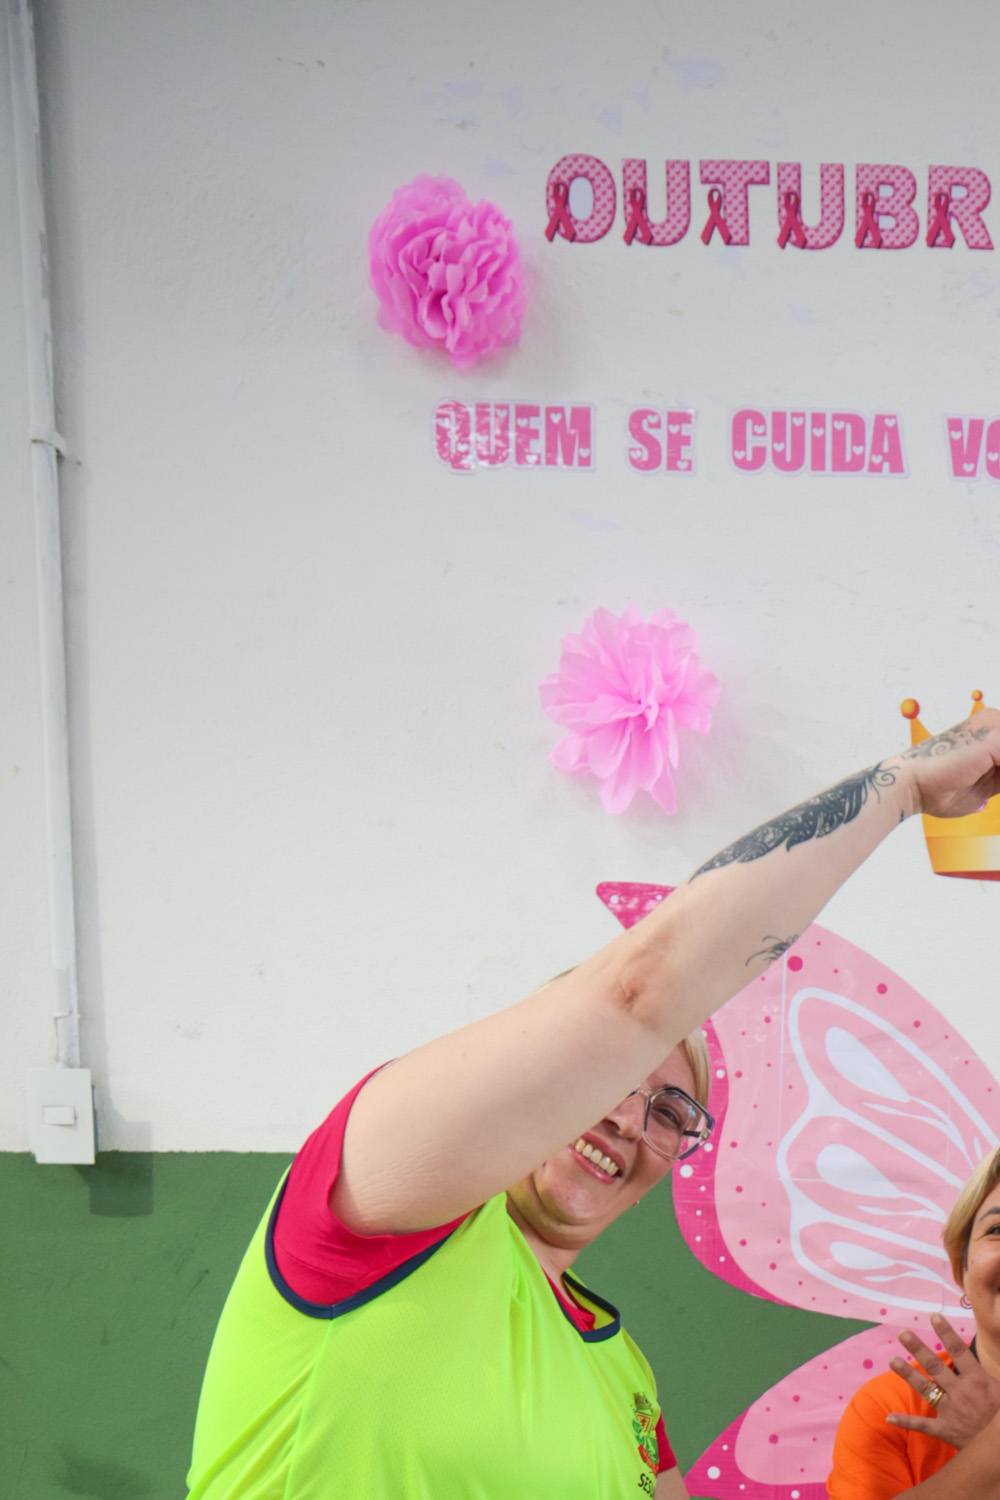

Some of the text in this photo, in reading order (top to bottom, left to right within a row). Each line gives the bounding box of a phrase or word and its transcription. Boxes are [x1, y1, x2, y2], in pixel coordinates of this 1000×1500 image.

[434, 400, 592, 472] QUEM
[628, 409, 694, 472] SE
[731, 409, 906, 475] CUIDA
